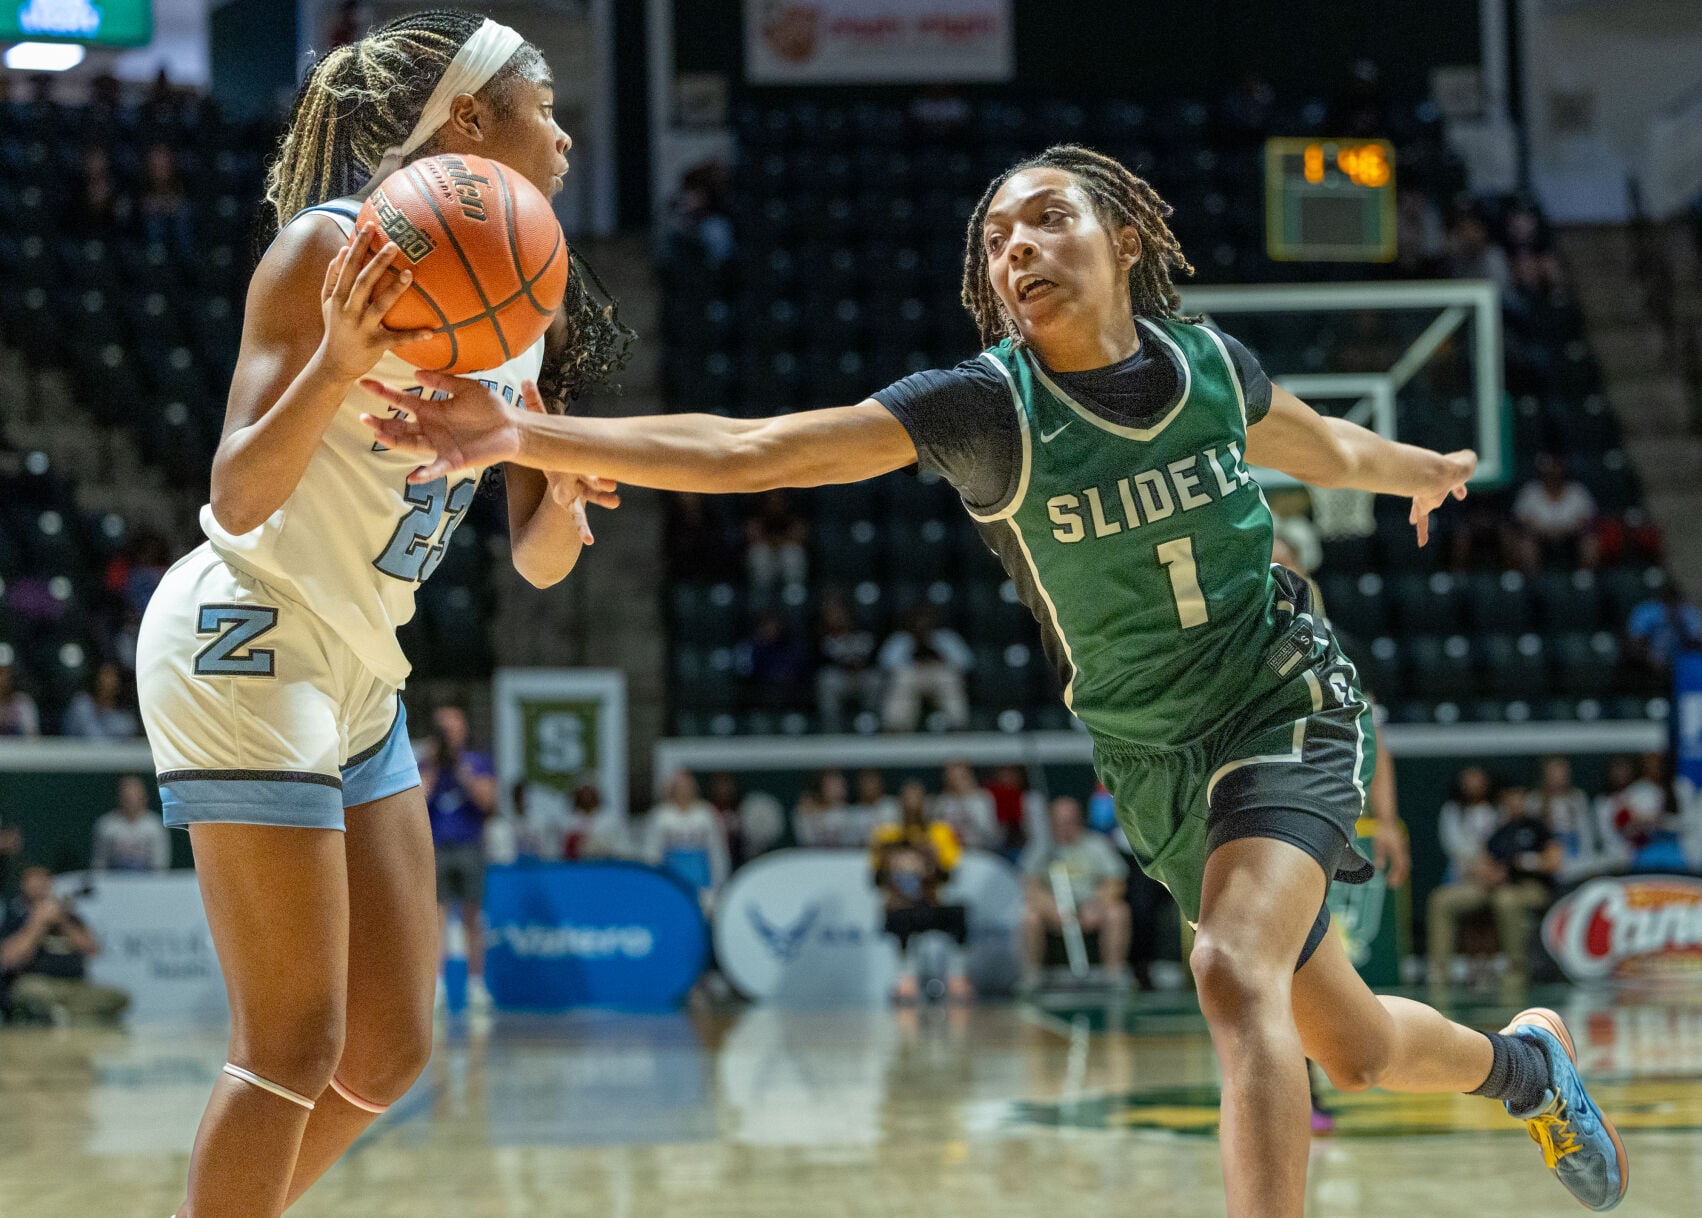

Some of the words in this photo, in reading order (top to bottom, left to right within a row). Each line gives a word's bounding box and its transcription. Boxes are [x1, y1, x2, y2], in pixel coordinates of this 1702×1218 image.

[1047, 441, 1249, 543] SLIDELL
[1157, 537, 1208, 629] 1
[194, 604, 279, 676] Z
[537, 712, 583, 772] S
